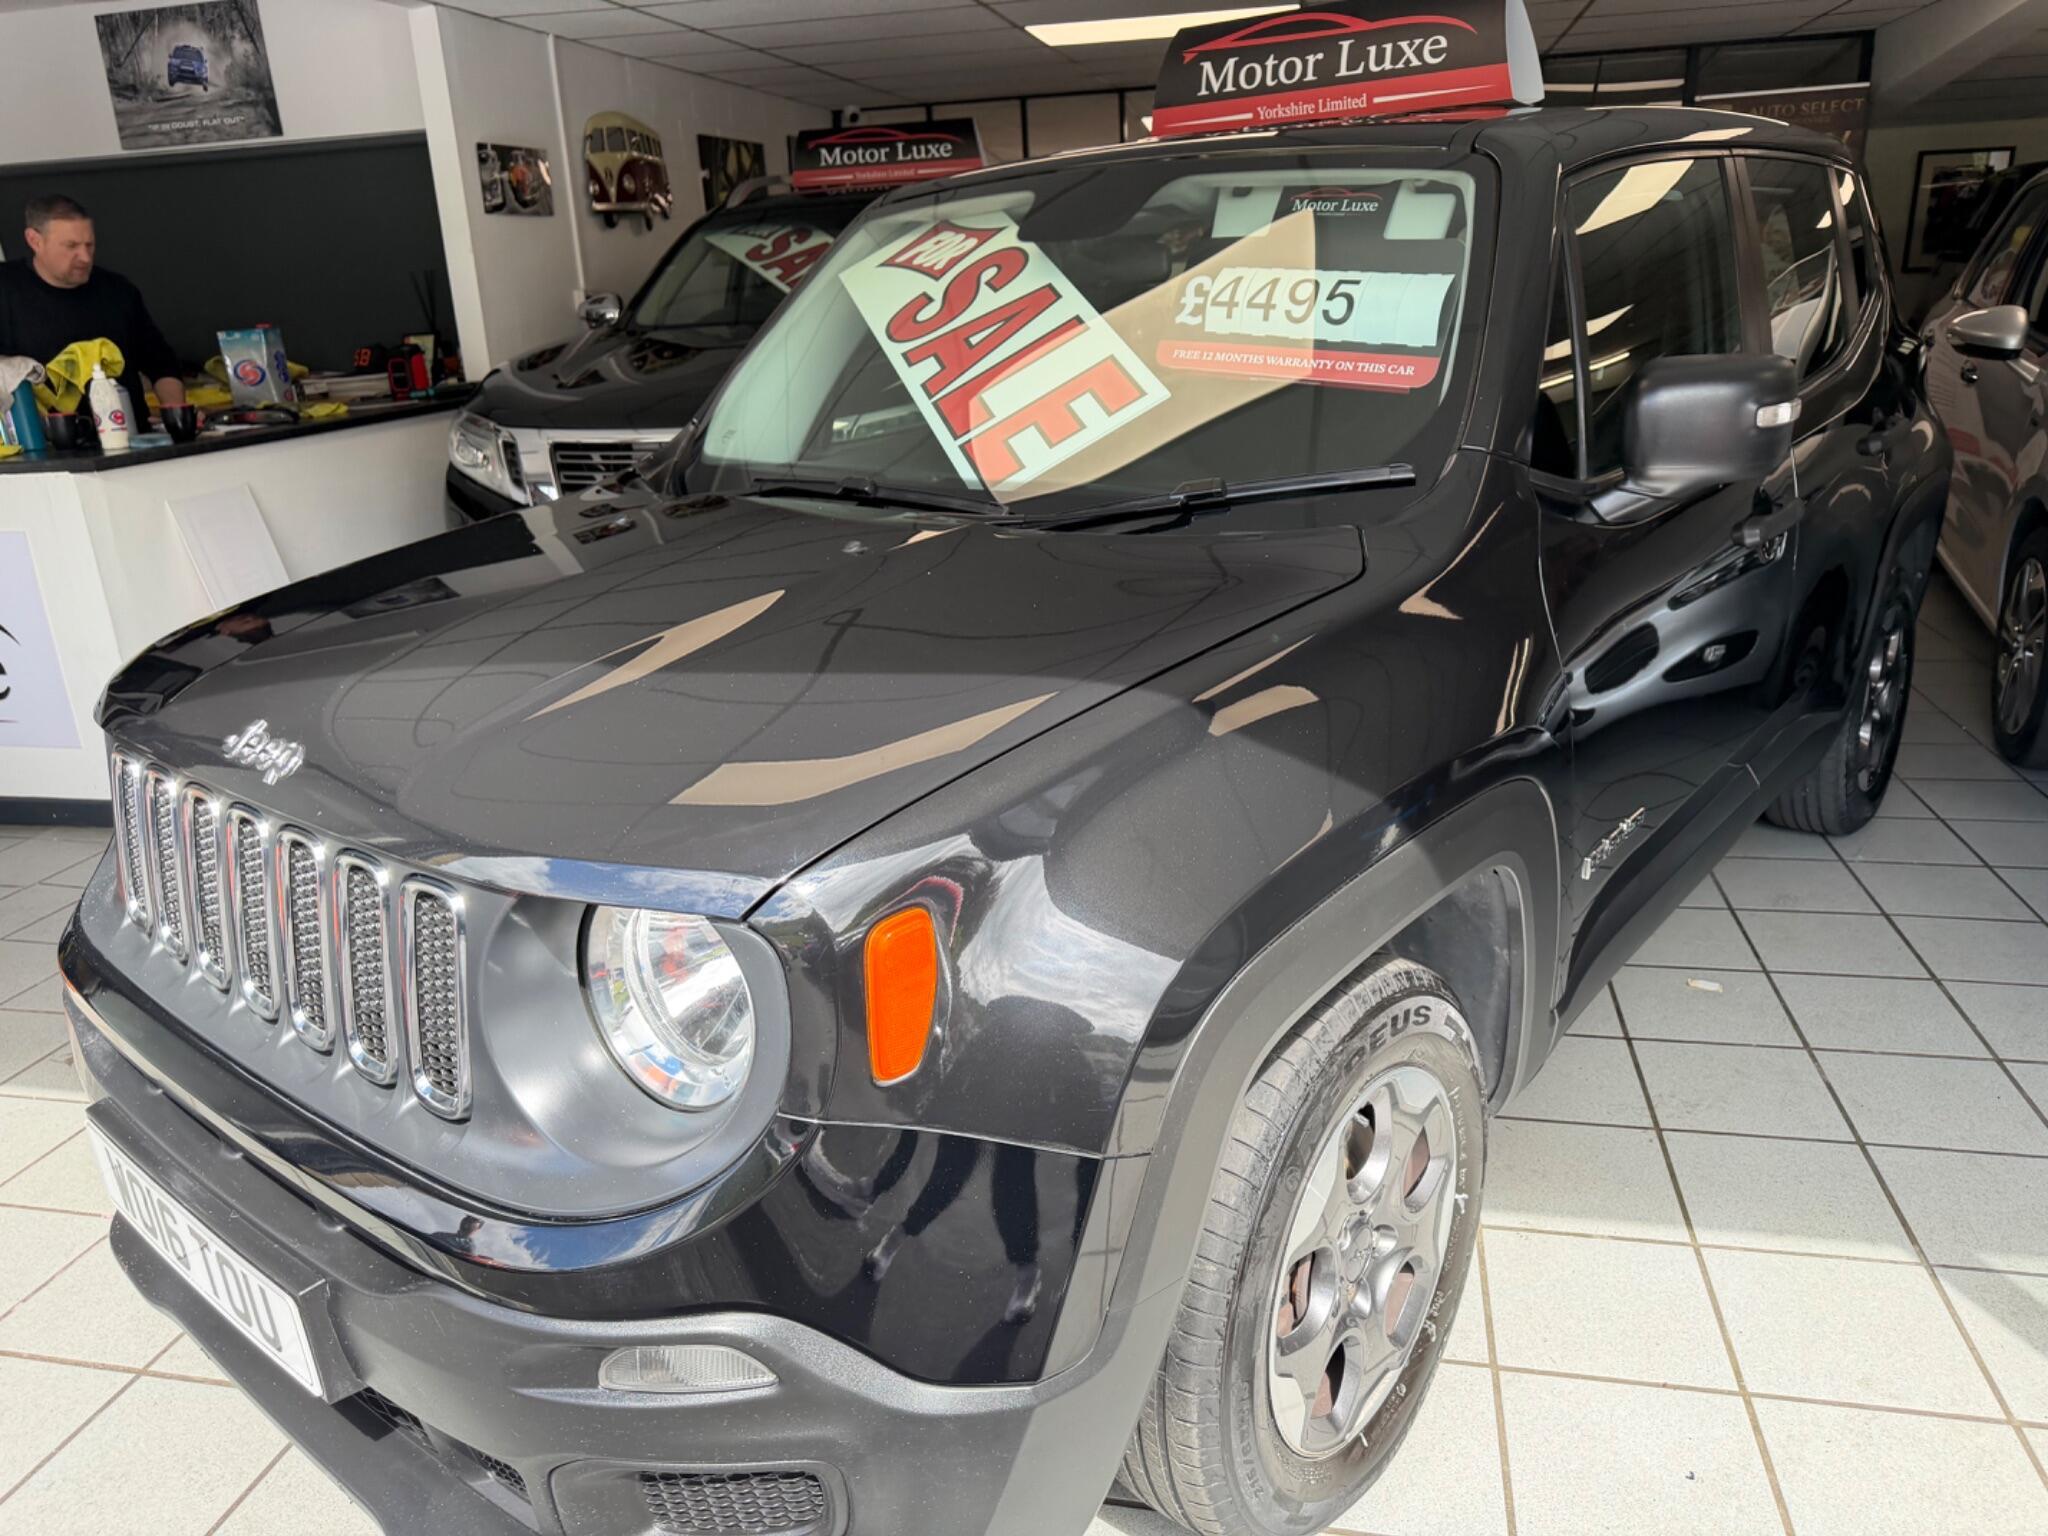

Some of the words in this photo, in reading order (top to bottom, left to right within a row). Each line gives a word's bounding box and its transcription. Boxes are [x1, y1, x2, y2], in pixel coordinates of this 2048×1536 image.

[1197, 51, 1325, 97] Motor
[1335, 34, 1448, 78] Luxe
[1256, 101, 1316, 121] Yorkshire
[1317, 94, 1368, 113] Limited
[1800, 98, 1865, 115] SELECT
[818, 146, 890, 167] Motor
[895, 141, 953, 161] Luxe
[1292, 199, 1338, 212] Motor
[1341, 199, 1379, 212] Luxe
[893, 230, 979, 272] FOR
[884, 245, 1149, 490] SALE
[1172, 349, 1202, 359] FREE
[1202, 350, 1214, 361] 12
[1214, 352, 1265, 365] MONTHS
[1266, 355, 1333, 370] WARRANTY
[1334, 360, 1353, 371] ON
[1355, 361, 1386, 374] THIS
[1387, 364, 1416, 376] CAR
